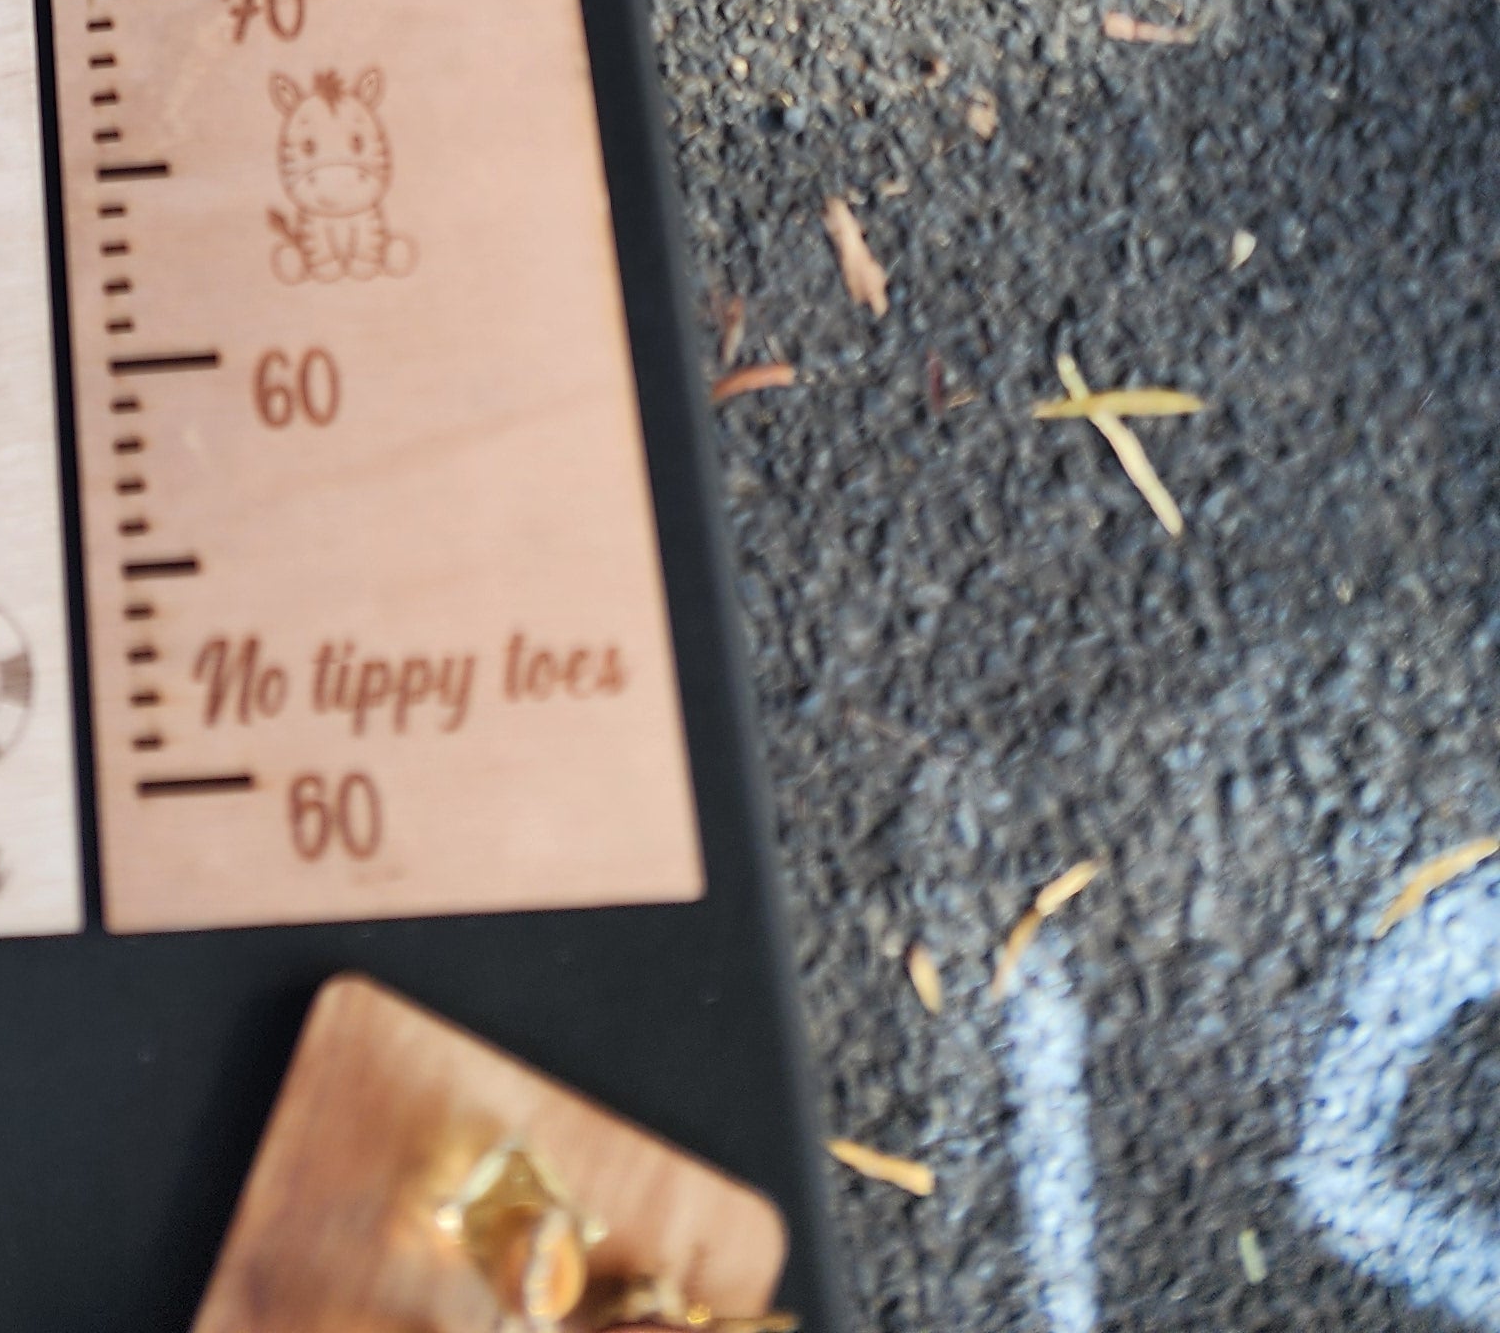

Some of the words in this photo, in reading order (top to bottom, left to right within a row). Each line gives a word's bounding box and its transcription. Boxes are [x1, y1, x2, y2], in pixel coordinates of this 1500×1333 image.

[252, 347, 342, 428] 60
[192, 634, 290, 727] No
[311, 640, 478, 735] tippy
[504, 629, 627, 703] toes
